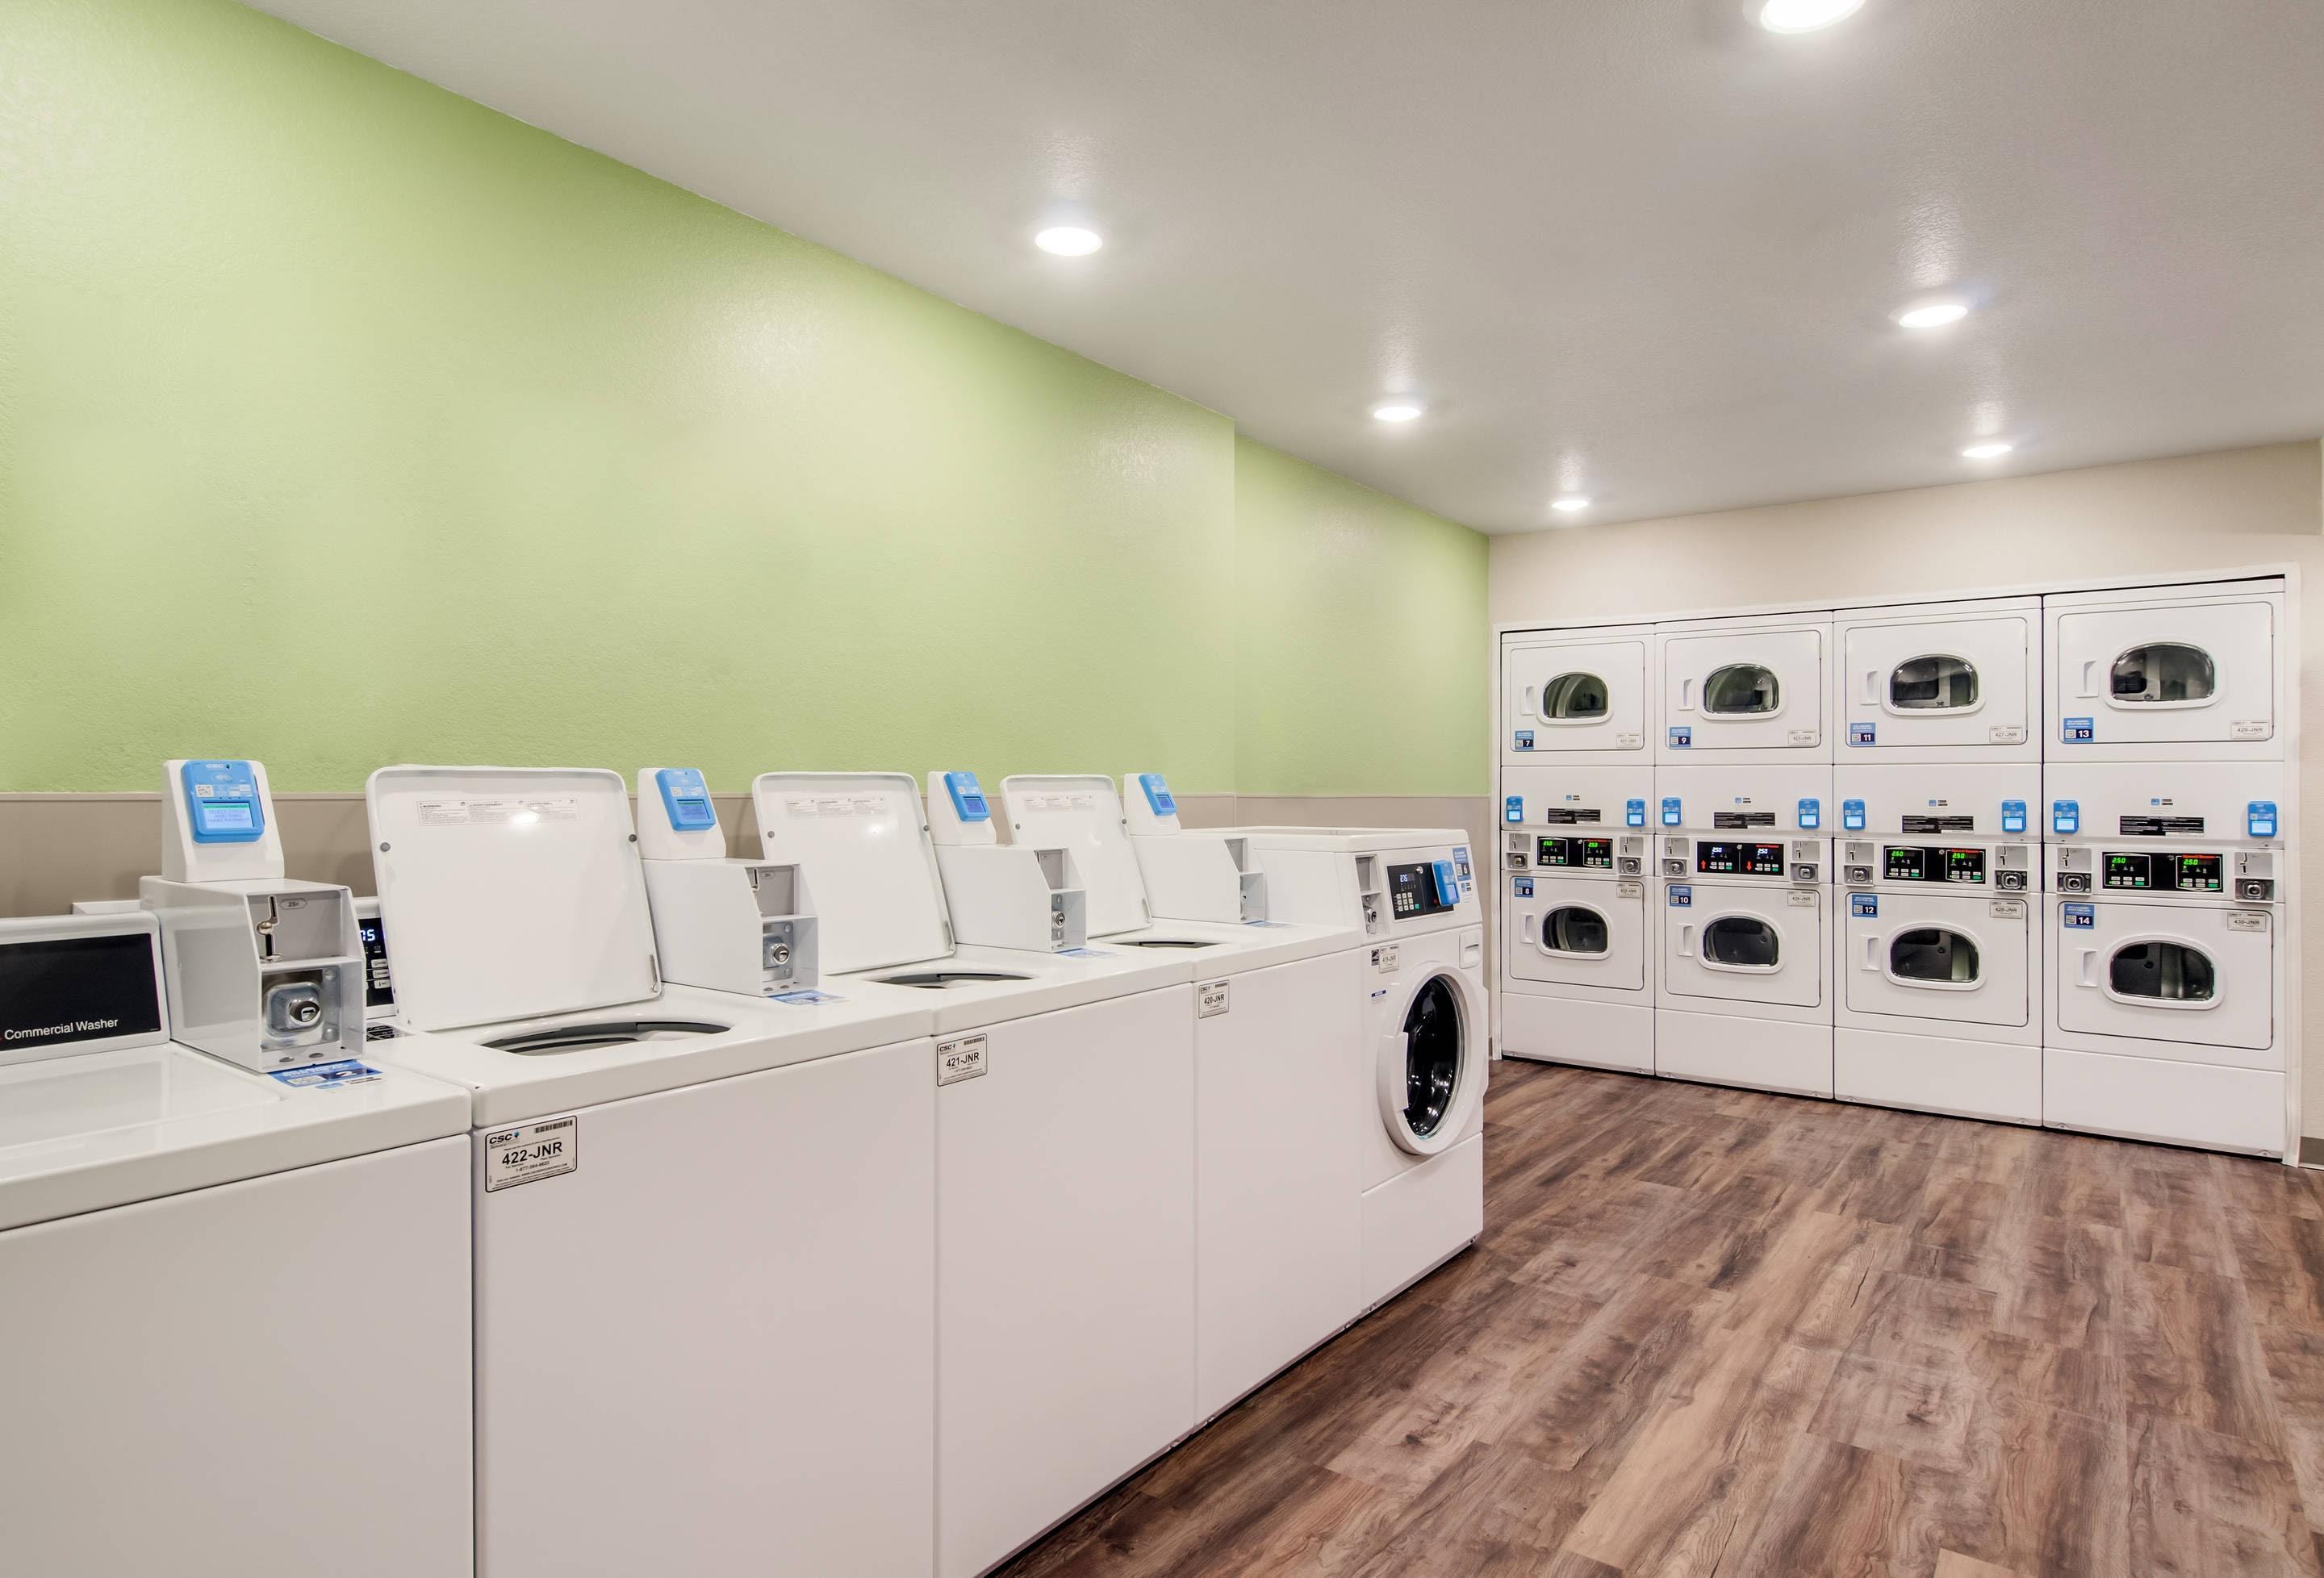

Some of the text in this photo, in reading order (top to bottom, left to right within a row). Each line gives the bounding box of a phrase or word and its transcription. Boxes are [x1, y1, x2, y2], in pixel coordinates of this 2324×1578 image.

[2078, 729, 2089, 738] 13
[1463, 865, 1468, 874] 6
[2078, 916, 2090, 925] 14
[1204, 993, 1225, 1004] 420-JNR
[4, 1018, 119, 1040] Commercial Washer
[939, 1044, 952, 1052] CSC
[946, 1052, 980, 1067] 421-JNR
[489, 1133, 512, 1144] CSC
[502, 1142, 562, 1165] 422-JNR
